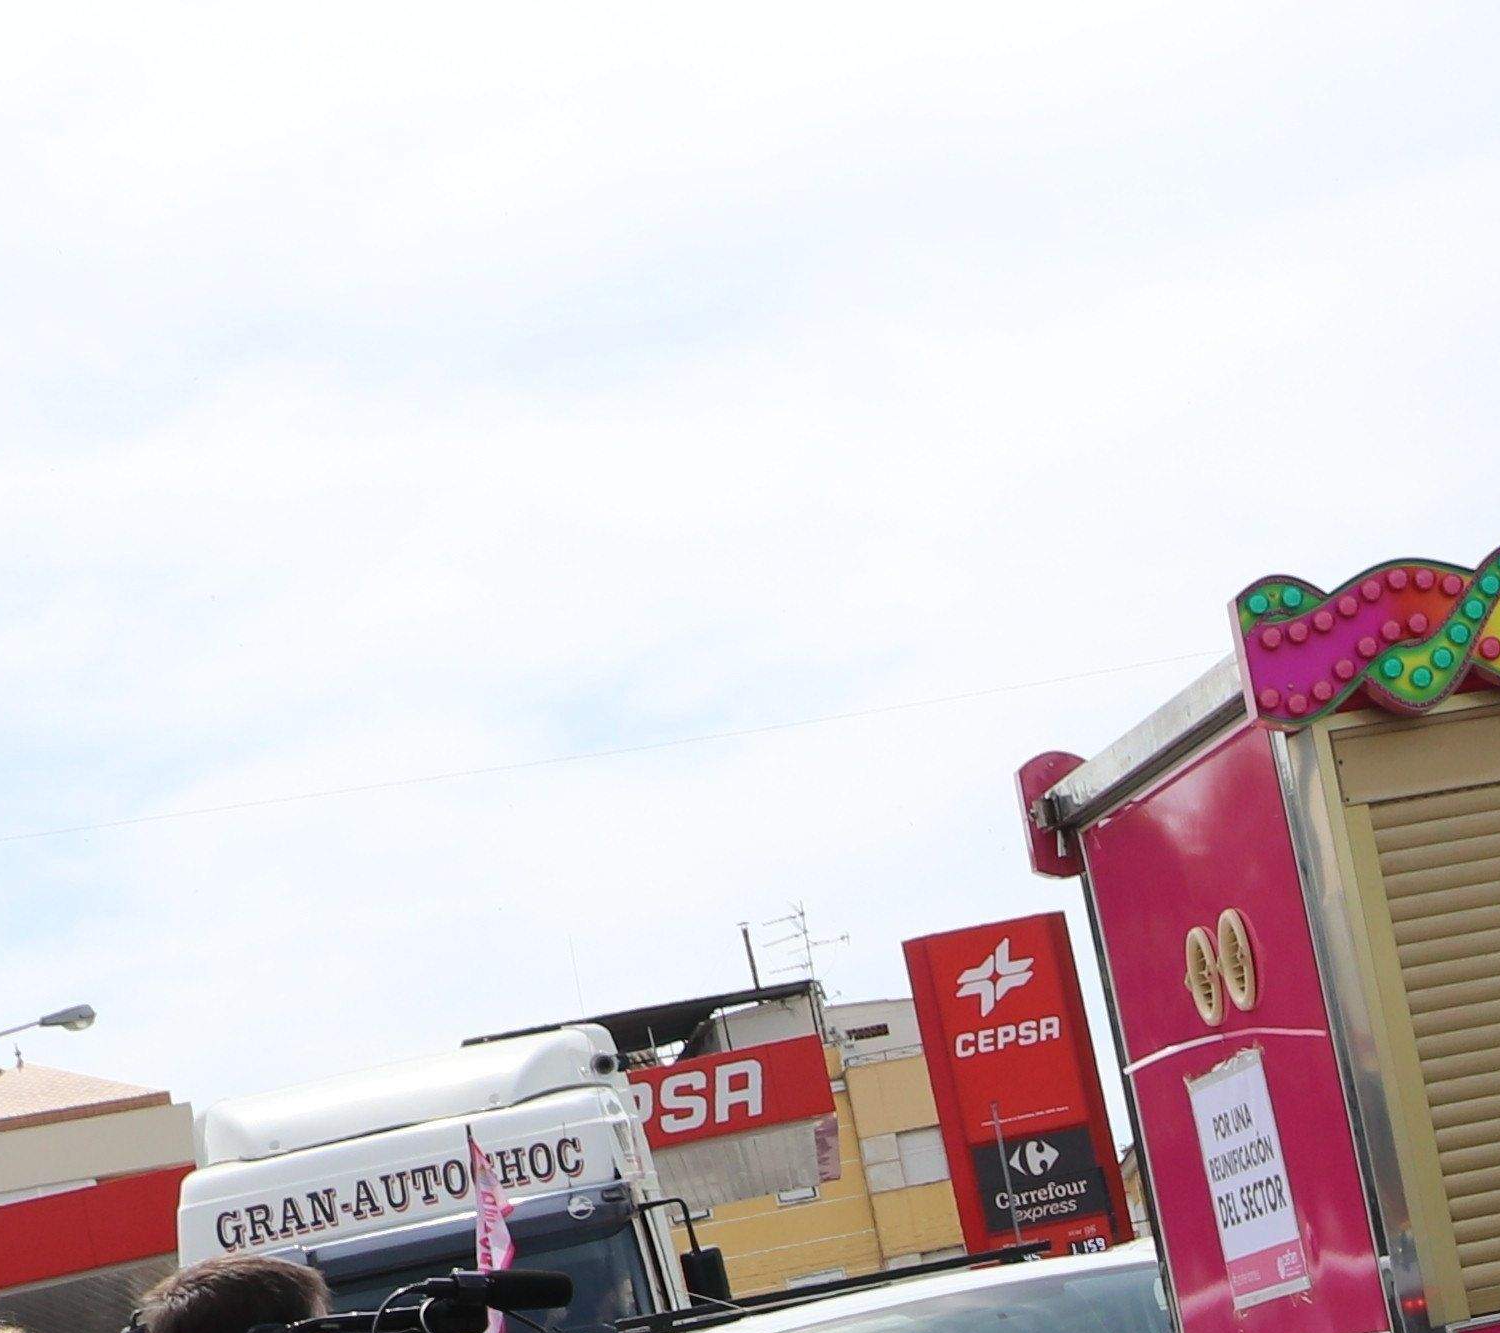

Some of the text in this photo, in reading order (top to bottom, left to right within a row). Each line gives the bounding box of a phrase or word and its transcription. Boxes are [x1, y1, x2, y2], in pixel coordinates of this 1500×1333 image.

[954, 1015, 1061, 1059] CEPSA
[1213, 1102, 1253, 1141] POR UNA
[1208, 1131, 1274, 1182] REUNIFICACIÓN
[1014, 1199, 1079, 1223] express
[1218, 1174, 1287, 1229] DEL SECTOR
